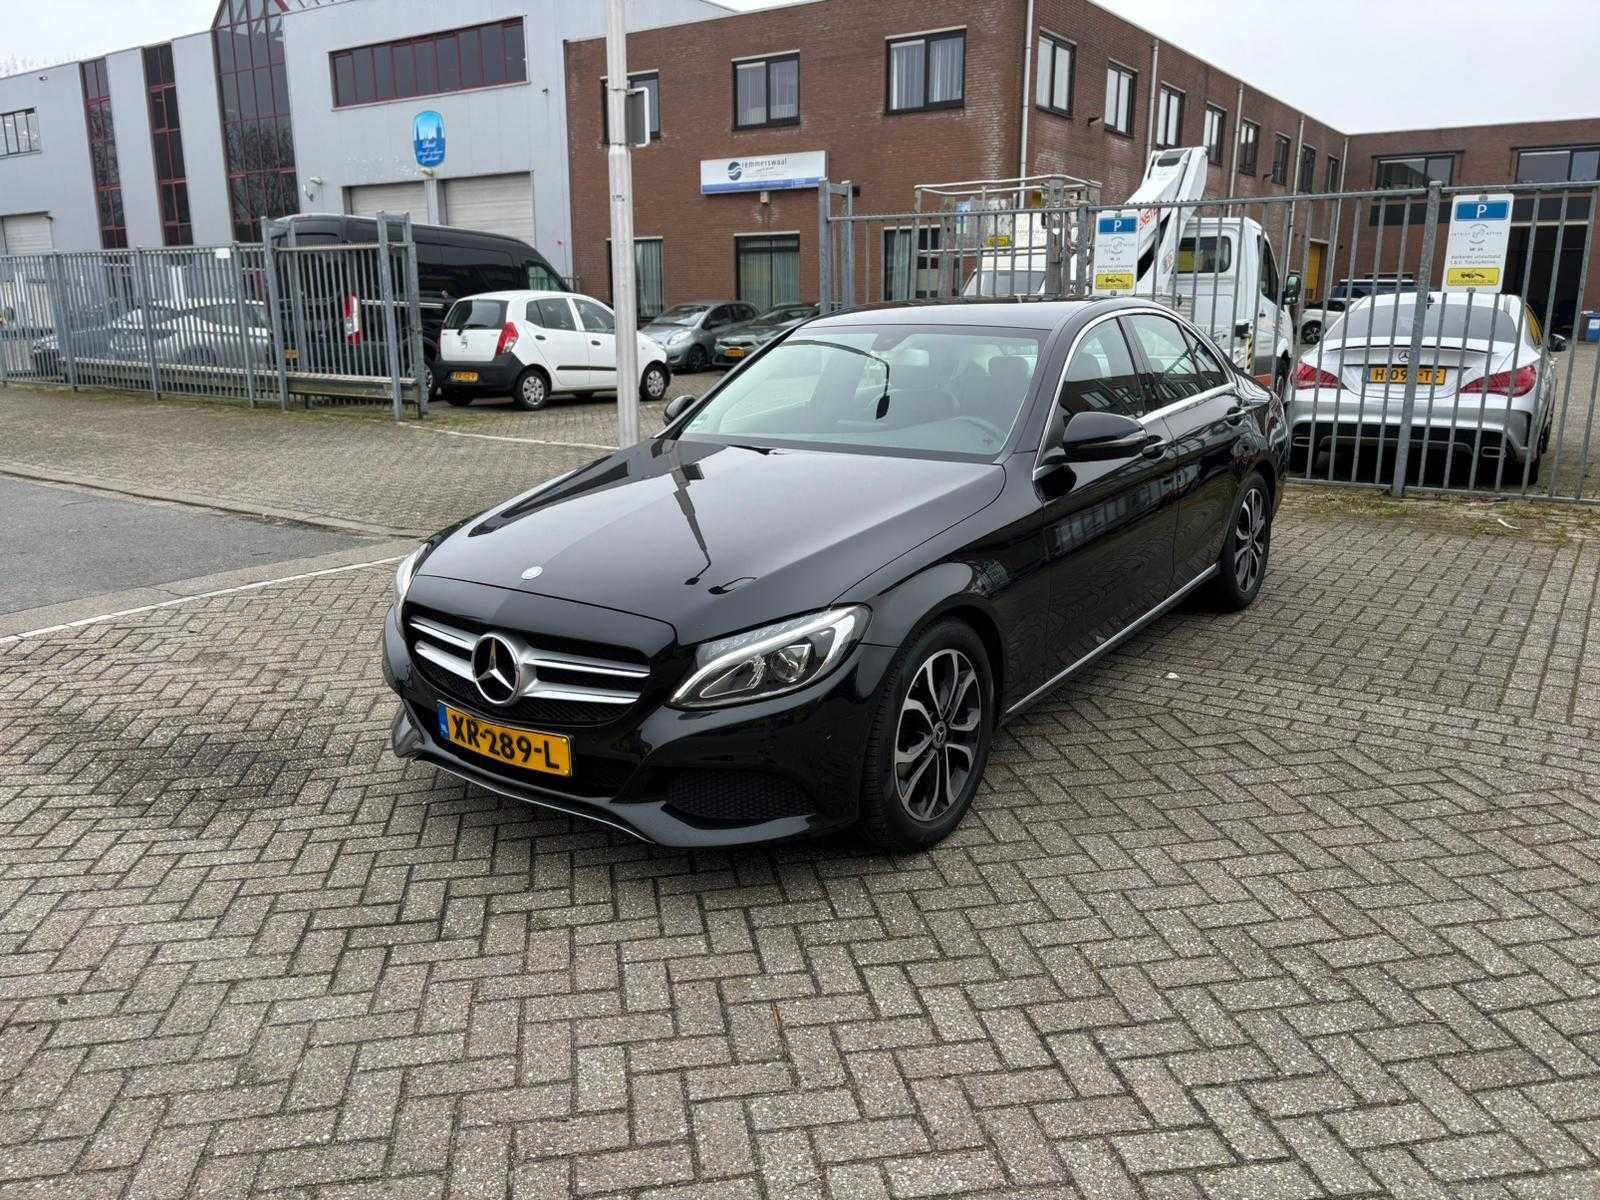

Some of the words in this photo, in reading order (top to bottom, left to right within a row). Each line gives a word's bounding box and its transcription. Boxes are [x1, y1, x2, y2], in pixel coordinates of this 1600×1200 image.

[1476, 204, 1488, 219] P
[1113, 219, 1122, 232] P
[1374, 368, 1441, 382] H-09-T
[451, 714, 560, 770] XR-289-L
